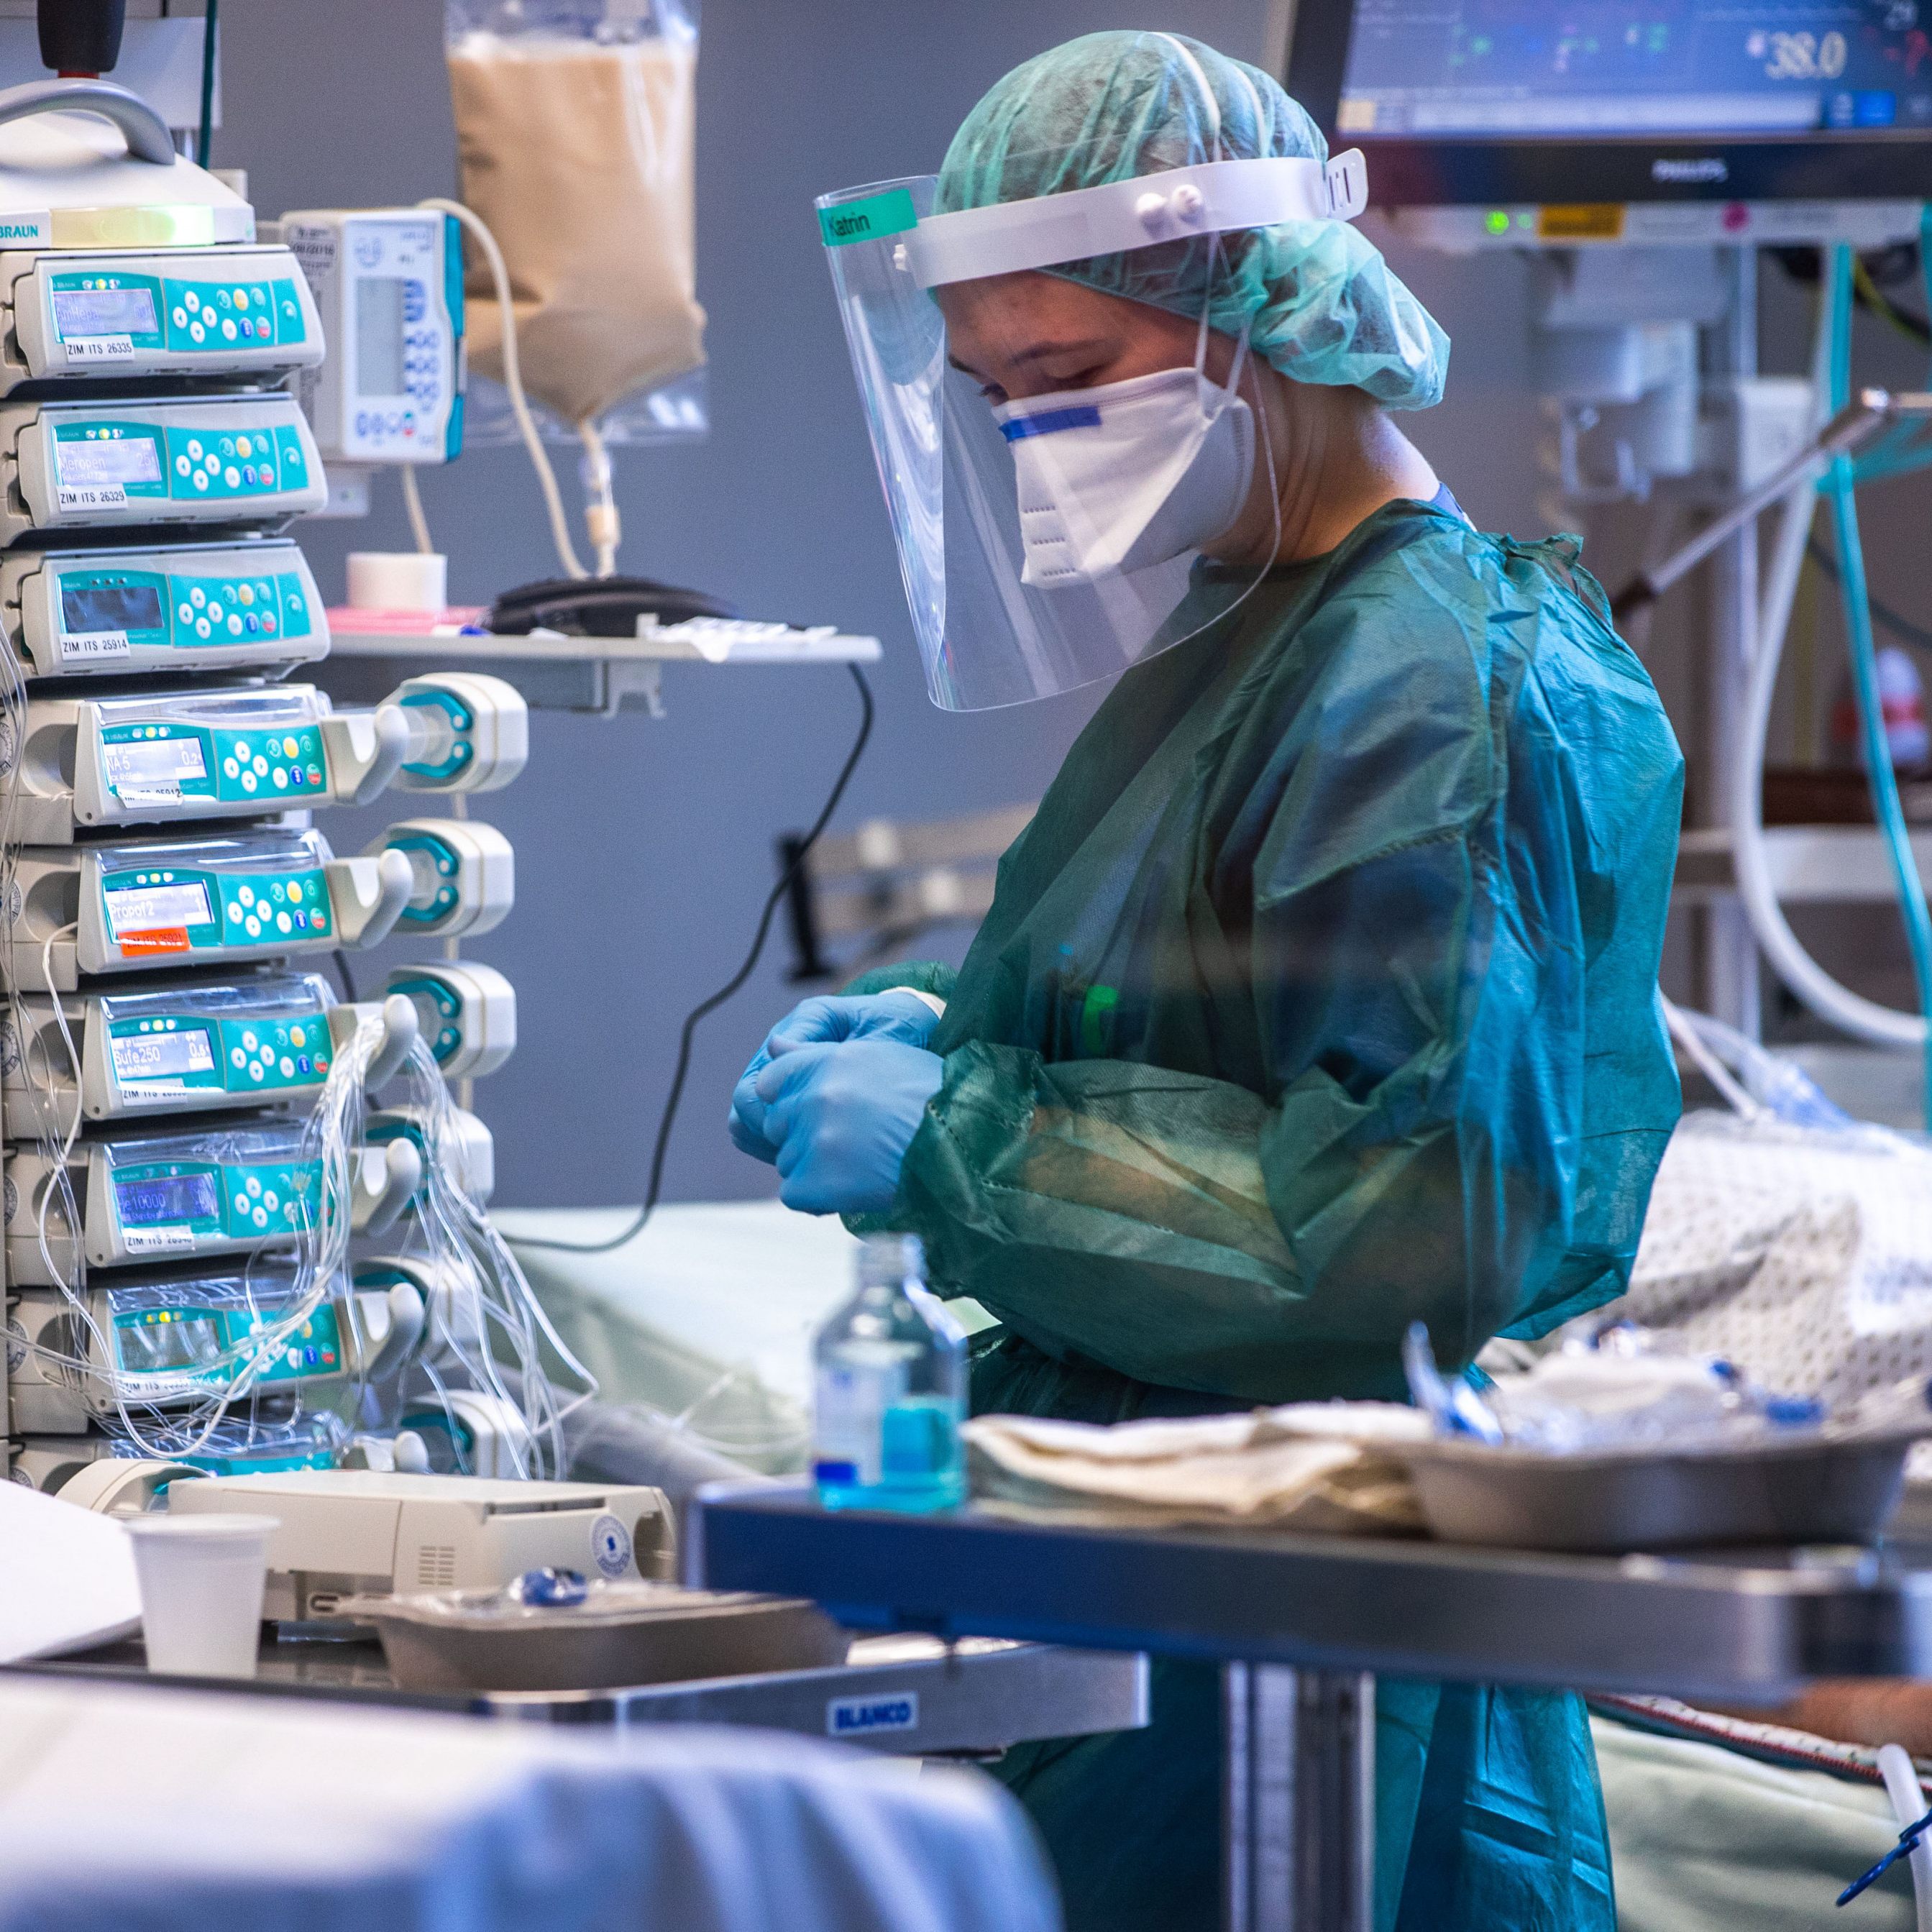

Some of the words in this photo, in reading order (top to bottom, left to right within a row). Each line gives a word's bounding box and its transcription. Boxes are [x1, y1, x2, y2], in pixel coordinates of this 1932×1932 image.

[0, 225, 38, 238] BRAUN
[68, 344, 84, 355] ZIM
[89, 344, 103, 354] ITS
[108, 343, 132, 354] 26335
[60, 493, 77, 504] ZIM
[82, 493, 96, 503] ITS
[100, 491, 124, 502] 26329
[63, 642, 80, 653] ZIM
[84, 641, 98, 651] ITS
[102, 639, 127, 650] 25914
[124, 1089, 139, 1099] ZIM
[128, 1236, 145, 1246] ZIM
[835, 1701, 911, 1729] BLANCO
